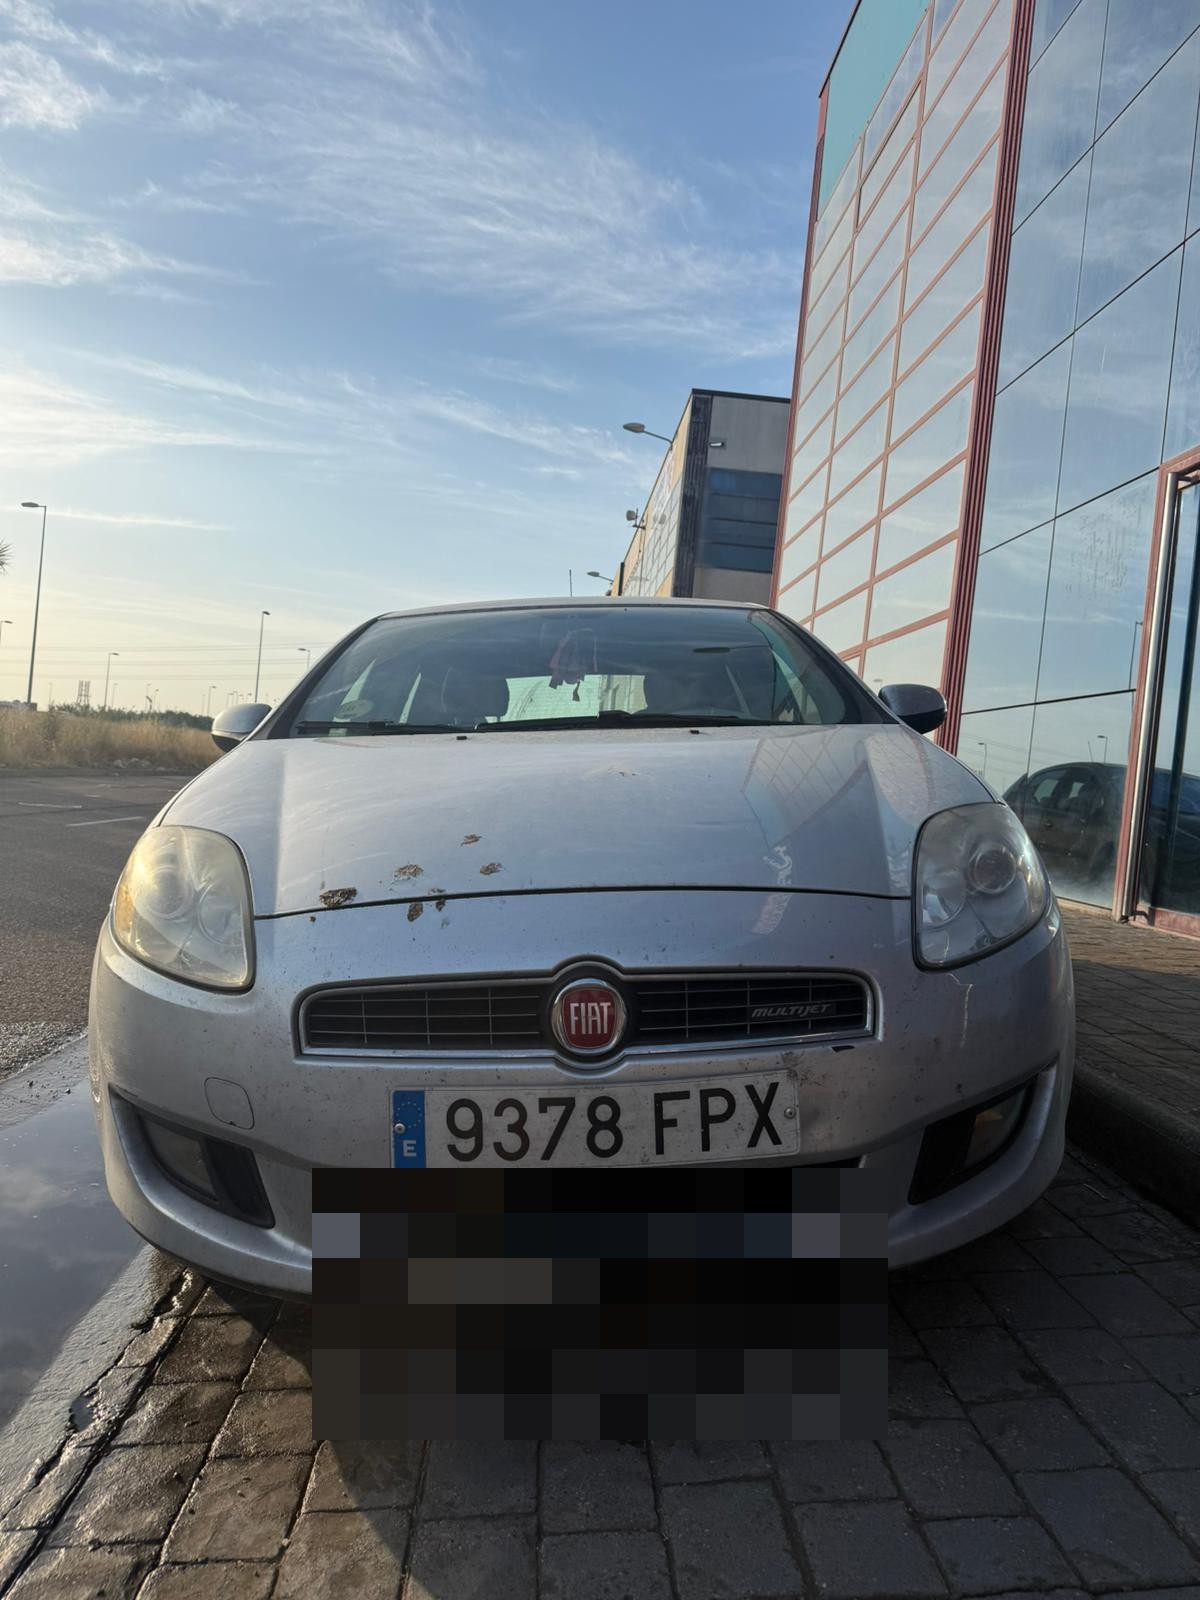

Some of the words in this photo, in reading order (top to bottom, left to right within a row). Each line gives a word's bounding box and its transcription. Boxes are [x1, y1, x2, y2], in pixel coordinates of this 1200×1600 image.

[570, 1002, 611, 1035] FIAT
[752, 1003, 831, 1018] MULTIJET
[446, 1095, 624, 1162] 9378
[654, 1081, 782, 1155] FPX
[403, 1140, 417, 1157] E
